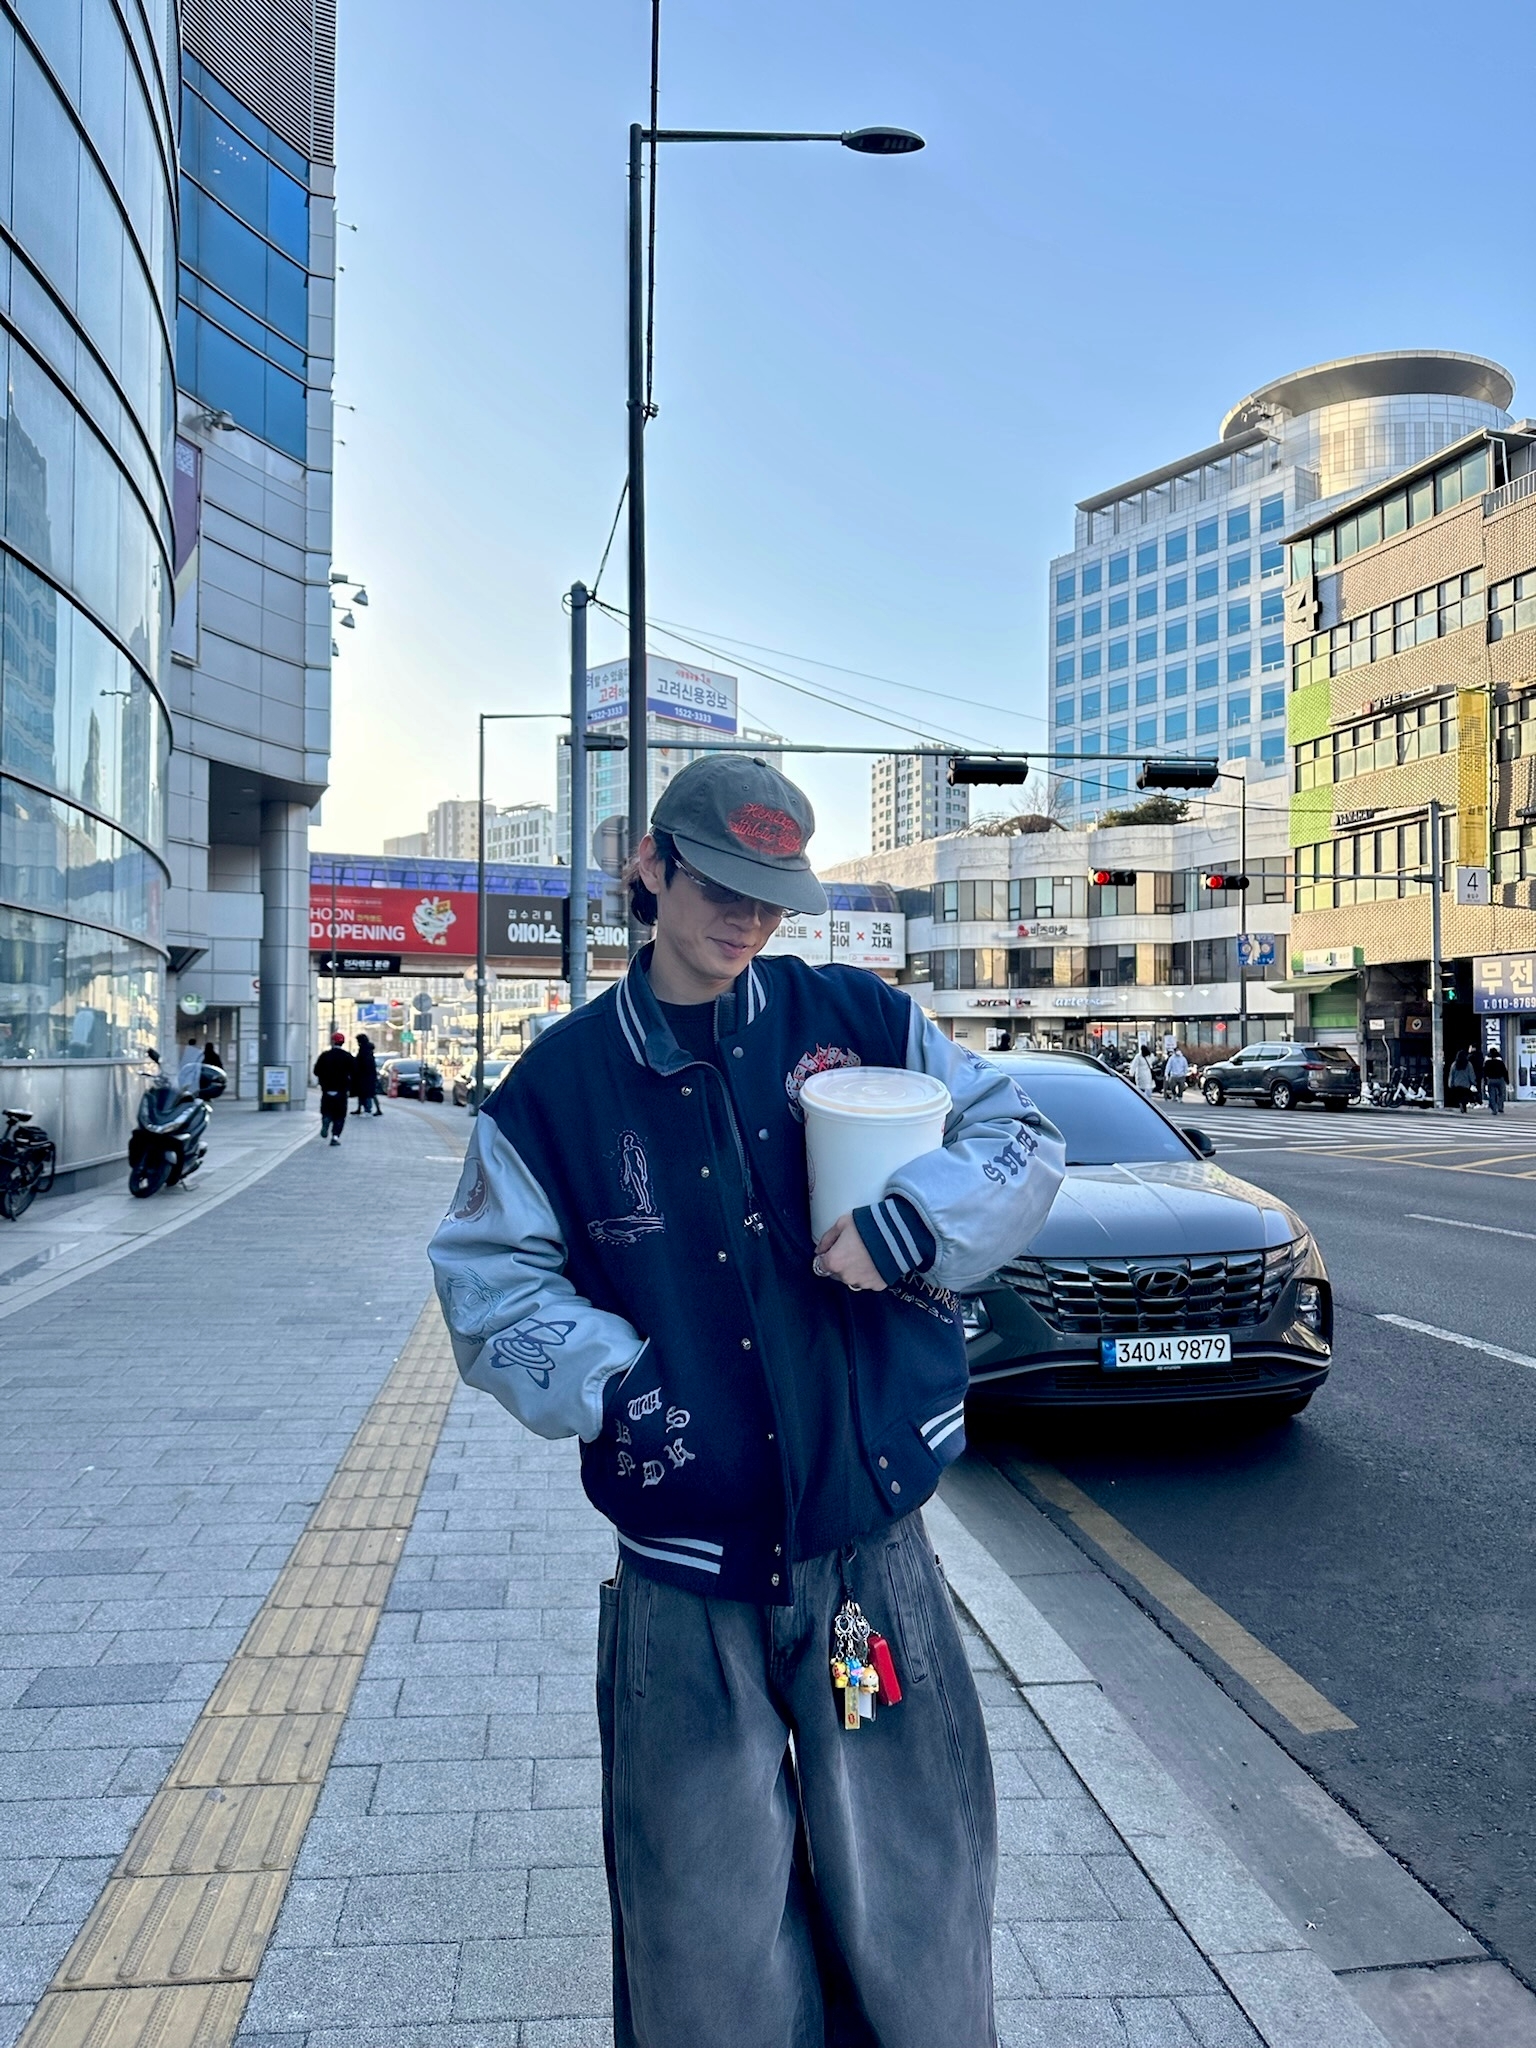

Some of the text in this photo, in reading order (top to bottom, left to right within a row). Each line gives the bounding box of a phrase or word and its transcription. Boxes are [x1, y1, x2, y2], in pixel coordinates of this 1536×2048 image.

[1291, 575, 1319, 631] 4
[656, 677, 728, 710] 고려신용정보
[591, 705, 623, 720] 1522-3333
[674, 706, 712, 723] 1522-3333
[1467, 871, 1479, 891] 4
[310, 922, 406, 941] D OPENING
[871, 922, 892, 935] 건축
[871, 936, 893, 949] 자재
[1118, 1338, 1226, 1363] 340서 9879
